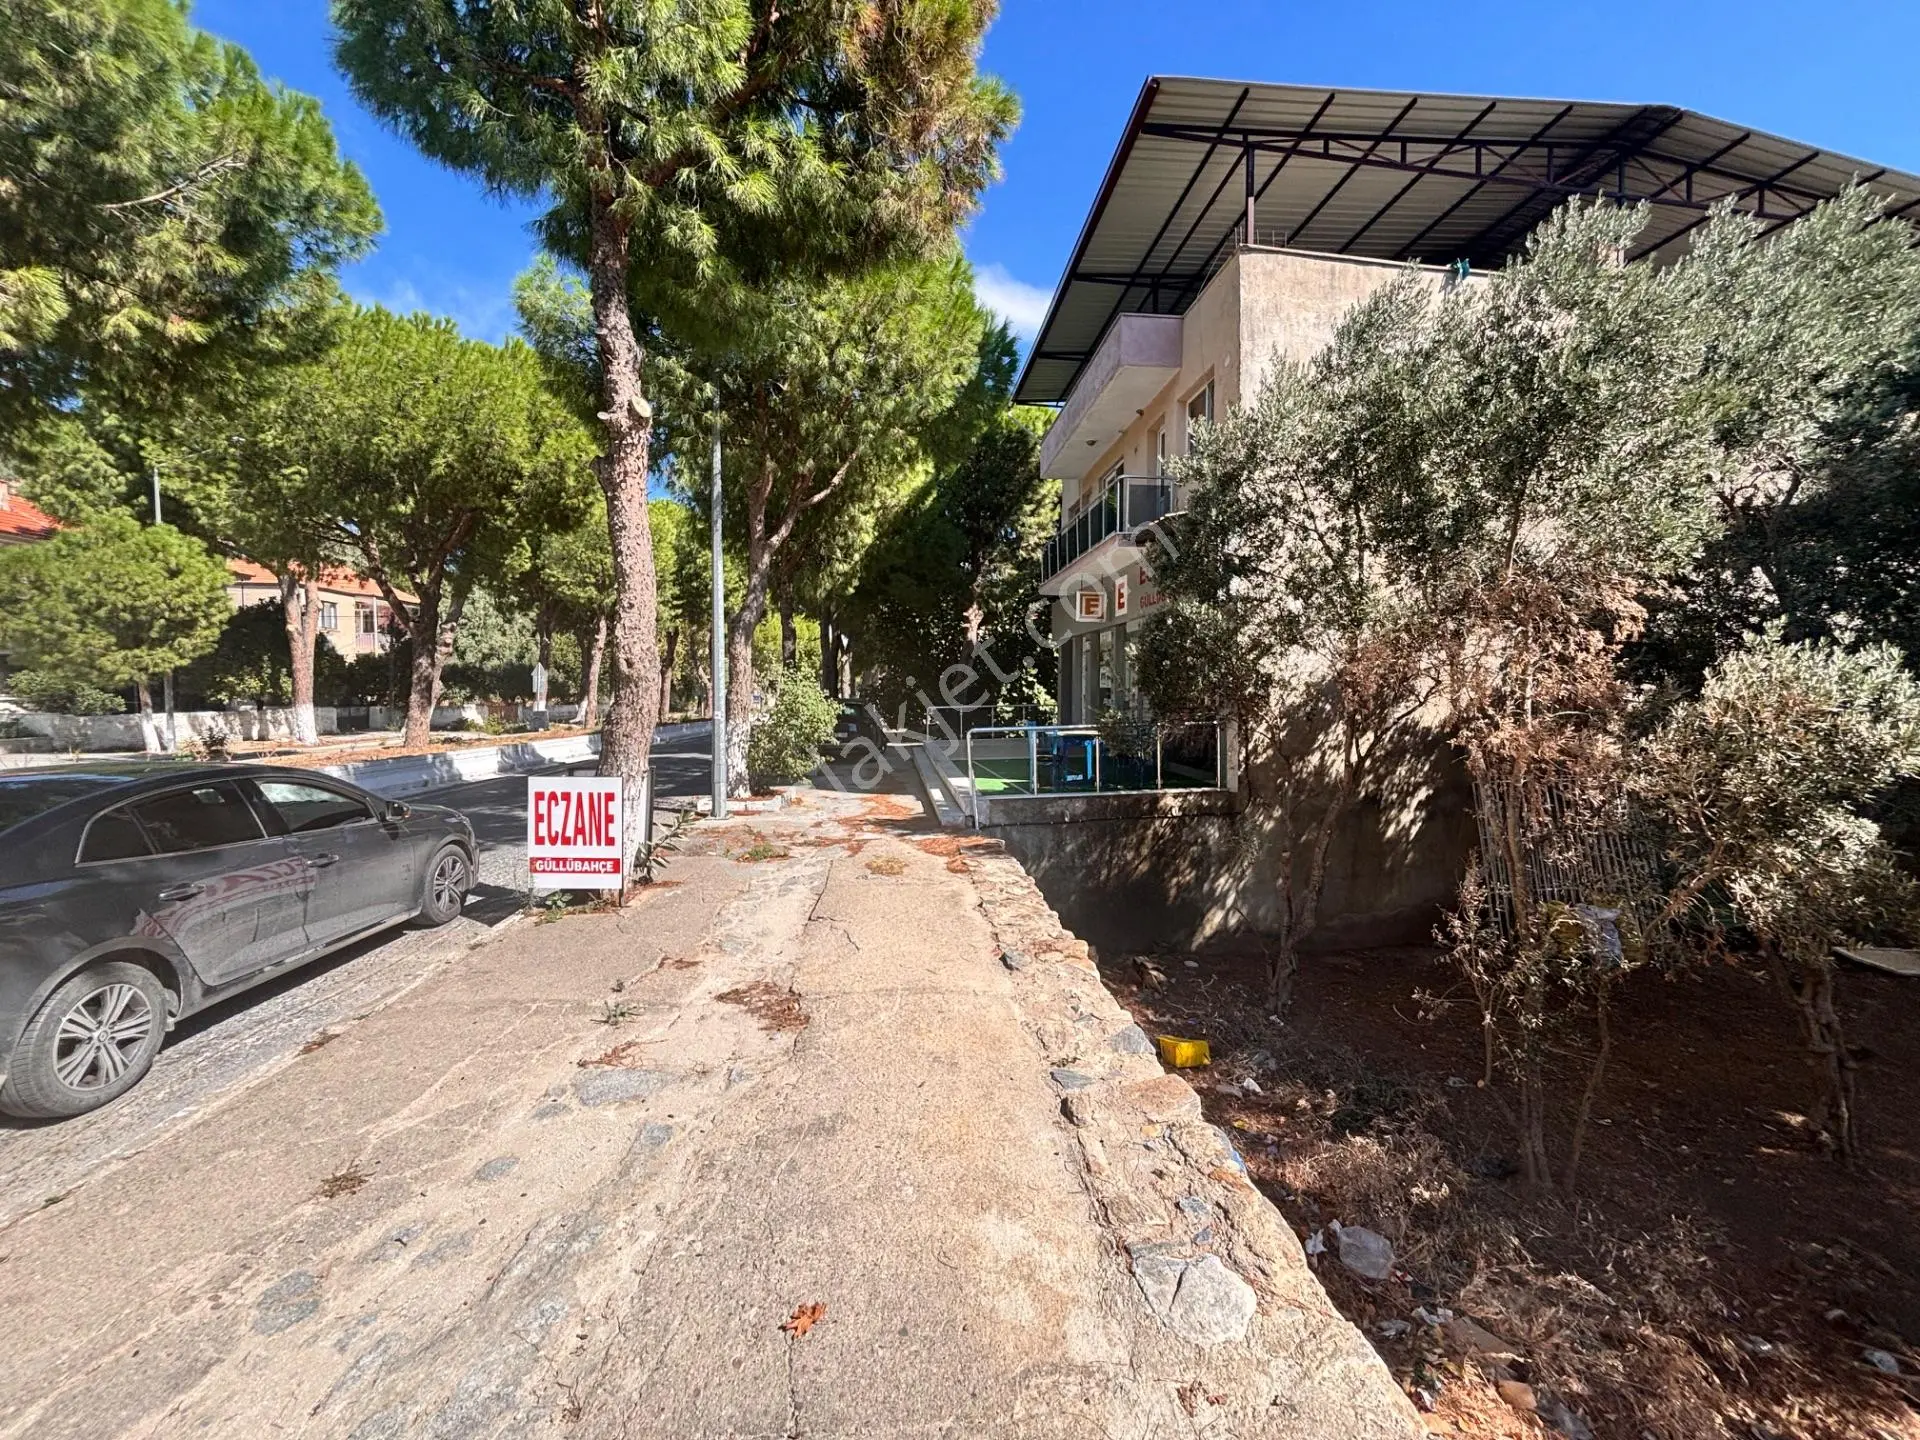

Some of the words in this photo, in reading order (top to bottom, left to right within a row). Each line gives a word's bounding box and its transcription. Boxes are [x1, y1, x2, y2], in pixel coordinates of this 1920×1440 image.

[1117, 582, 1126, 610] E
[534, 791, 615, 846] ECZANE
[535, 858, 614, 874] GÜLLÜBAHÇE
